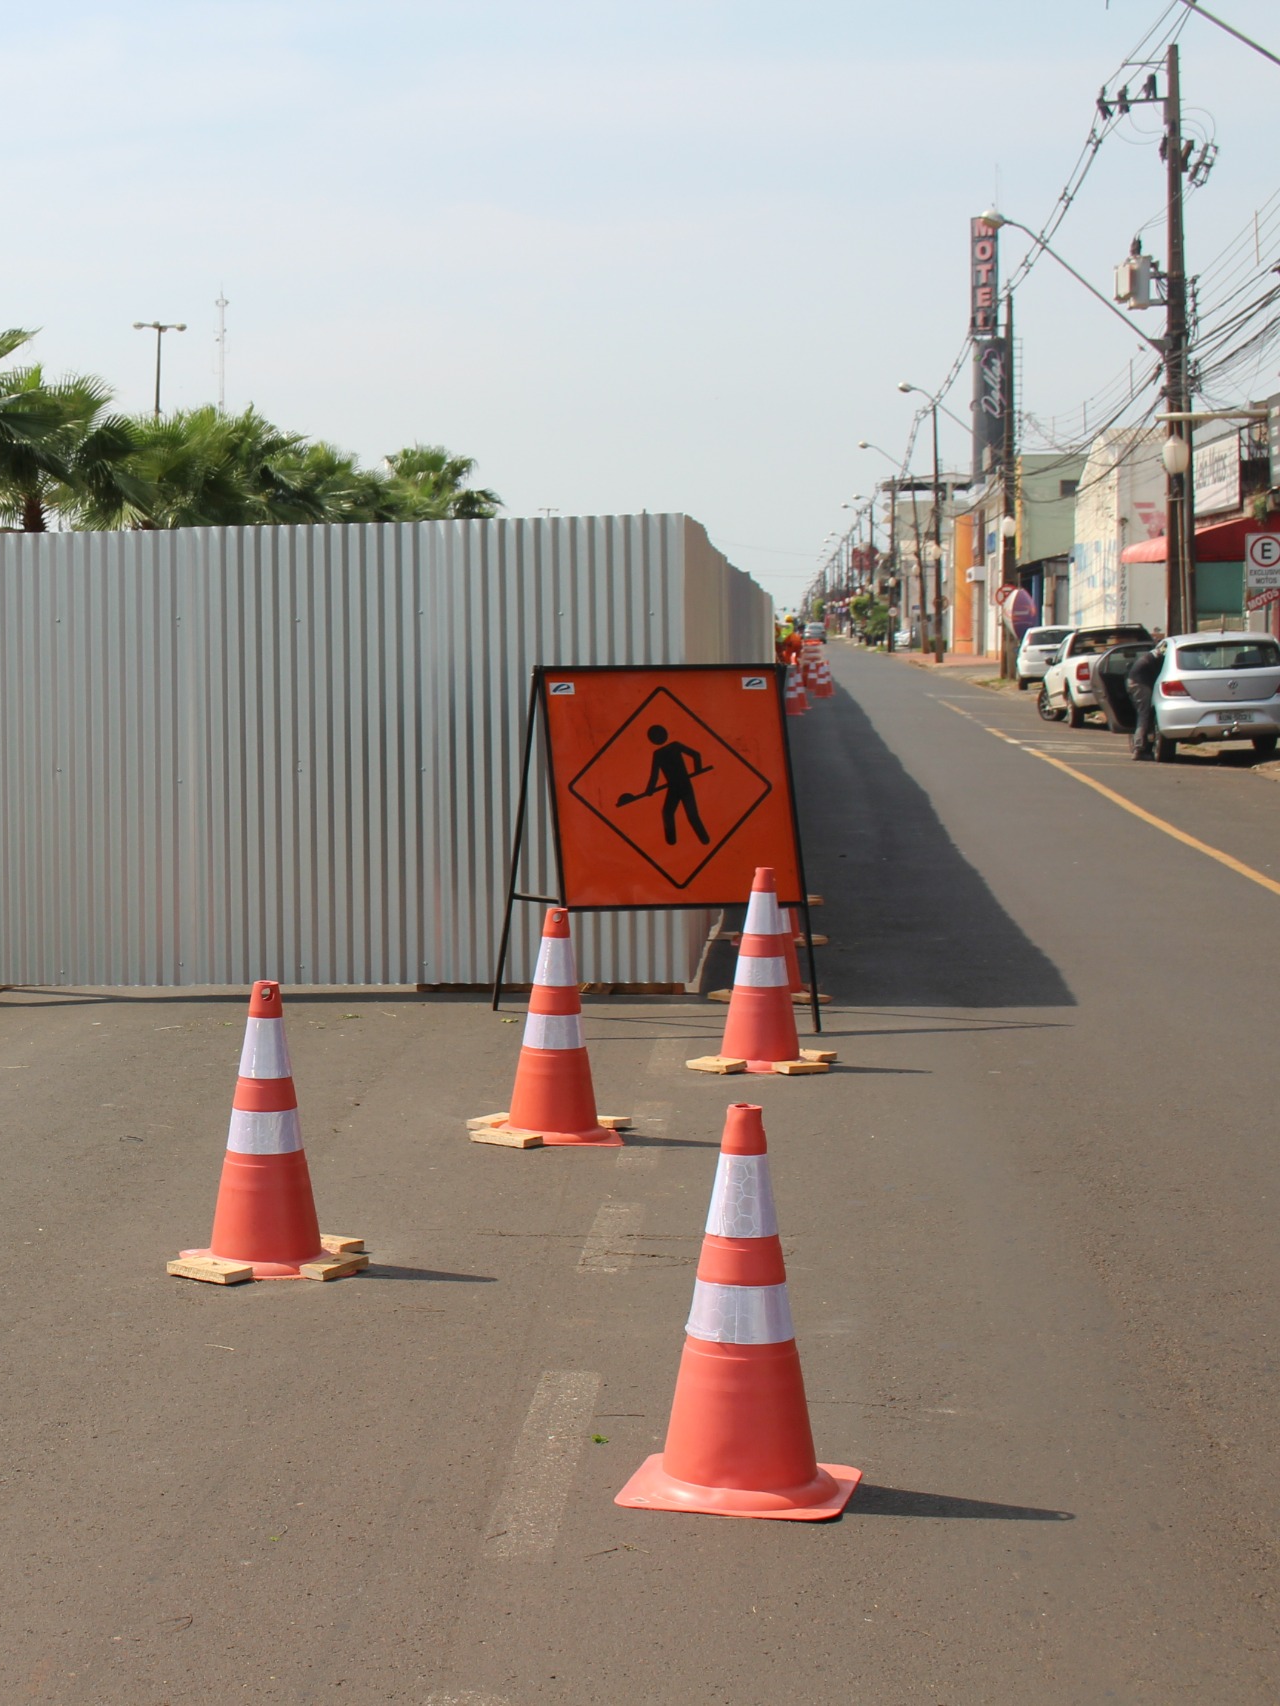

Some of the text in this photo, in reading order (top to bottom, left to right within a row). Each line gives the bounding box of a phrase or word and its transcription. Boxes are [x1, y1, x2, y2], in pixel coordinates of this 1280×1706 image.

[974, 218, 994, 331] MOTEL
[1261, 542, 1272, 559] E
[1247, 589, 1280, 609] MOTOS
